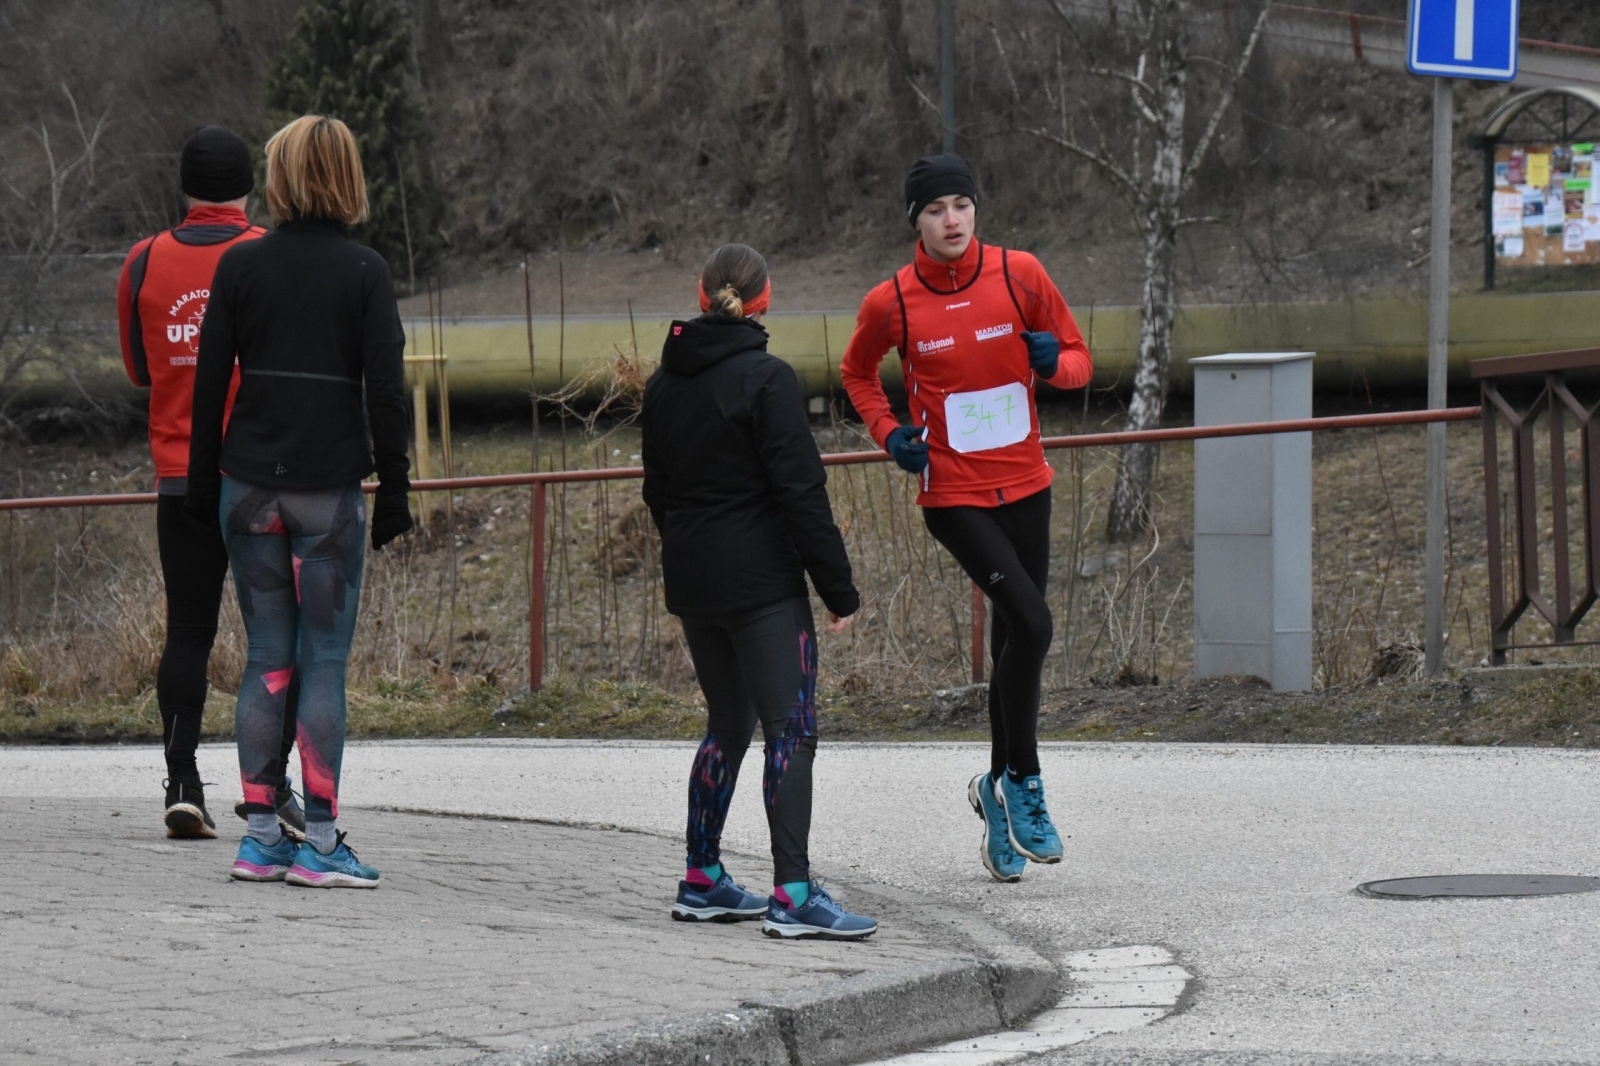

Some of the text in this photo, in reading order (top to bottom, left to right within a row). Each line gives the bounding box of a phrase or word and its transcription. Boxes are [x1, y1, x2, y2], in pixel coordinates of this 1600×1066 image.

[169, 289, 210, 317] MARATO
[975, 322, 1013, 337] MARATON
[958, 394, 1015, 435] 347
